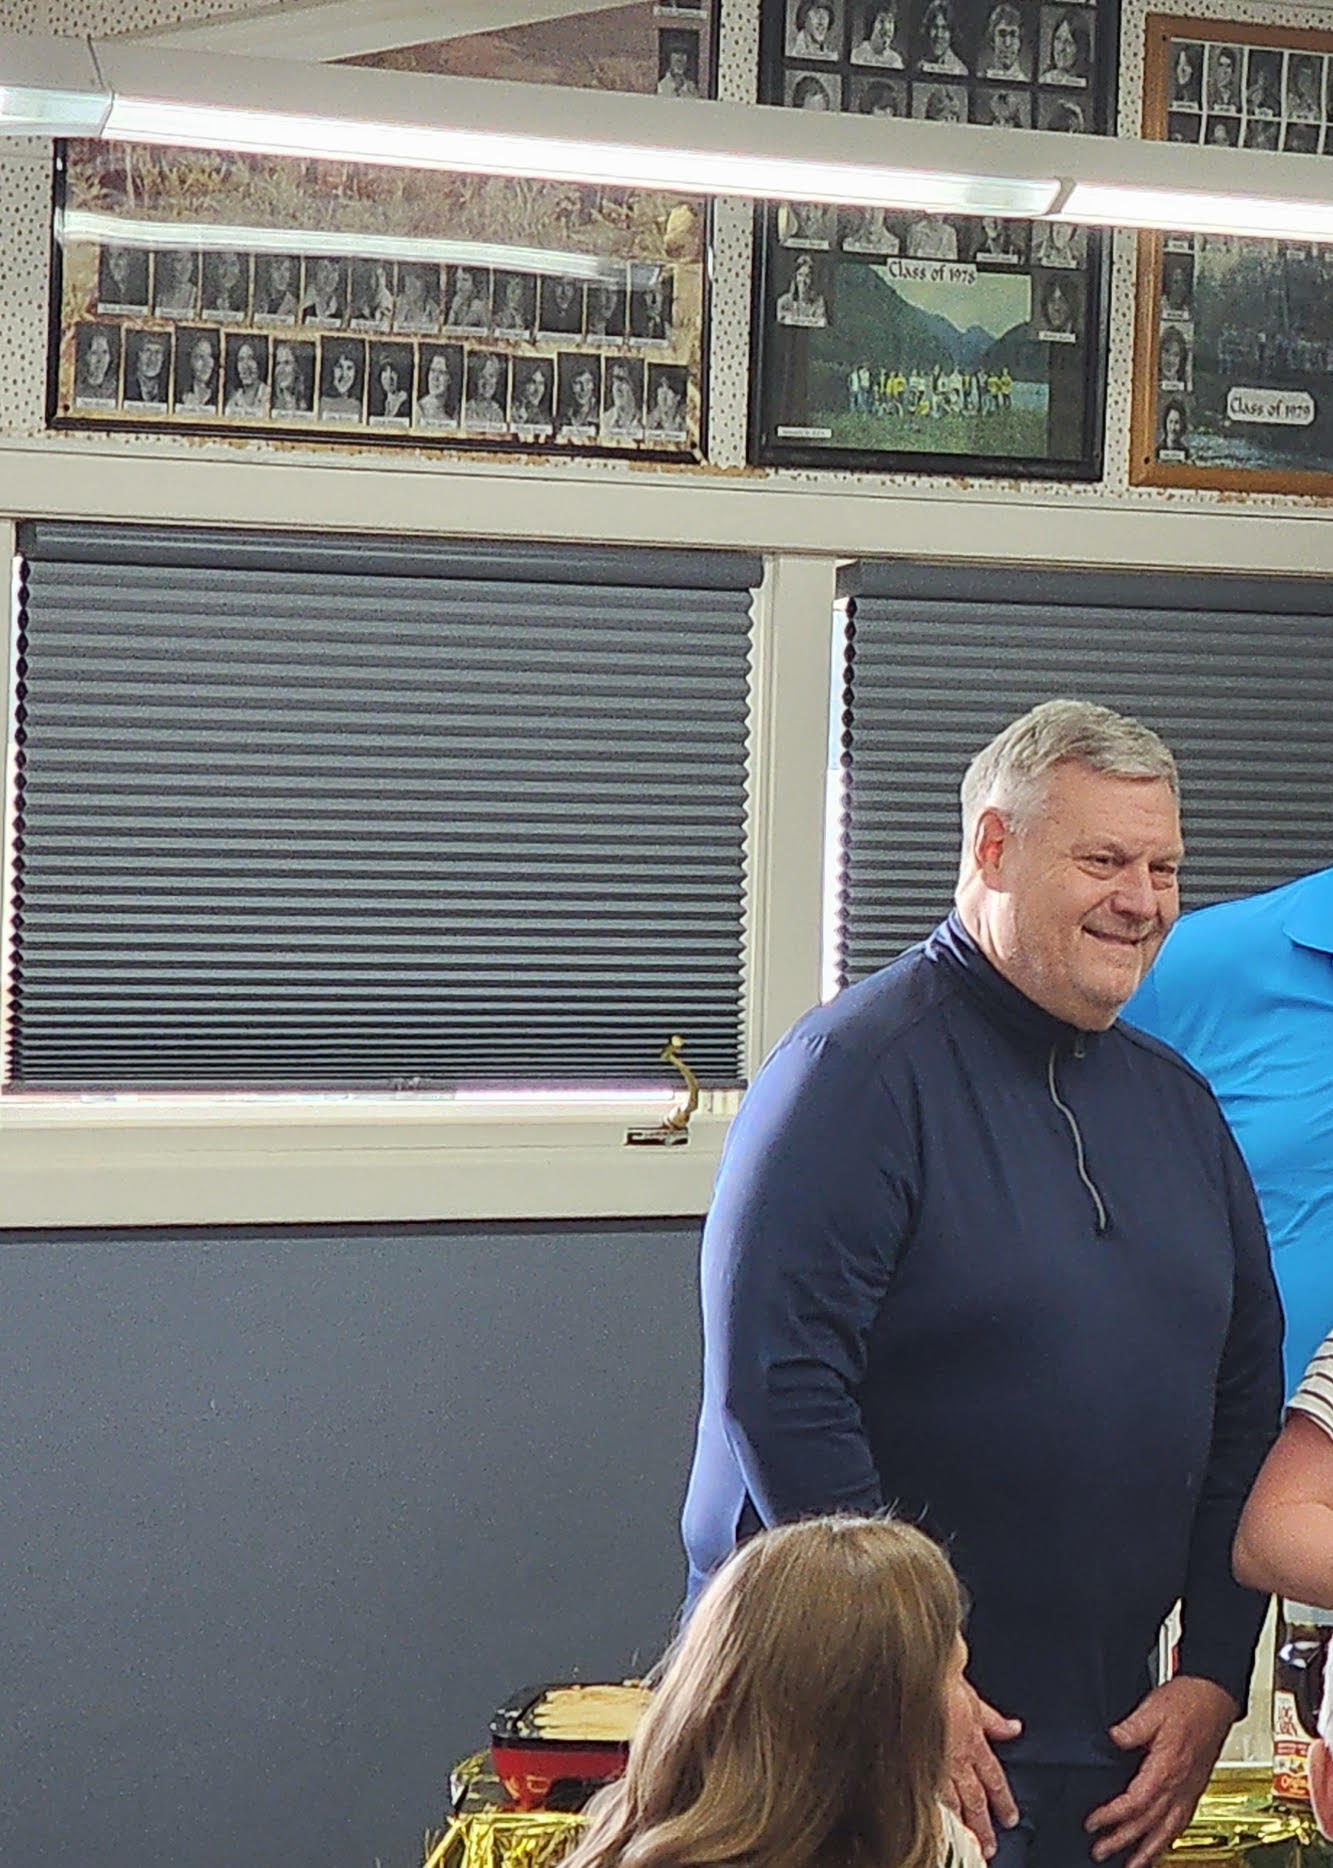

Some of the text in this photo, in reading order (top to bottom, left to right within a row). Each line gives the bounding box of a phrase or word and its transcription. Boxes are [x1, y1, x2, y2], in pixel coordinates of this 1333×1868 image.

[889, 261, 926, 280] Class
[931, 264, 946, 281] of
[1230, 396, 1264, 416] Class
[1267, 399, 1282, 416] of
